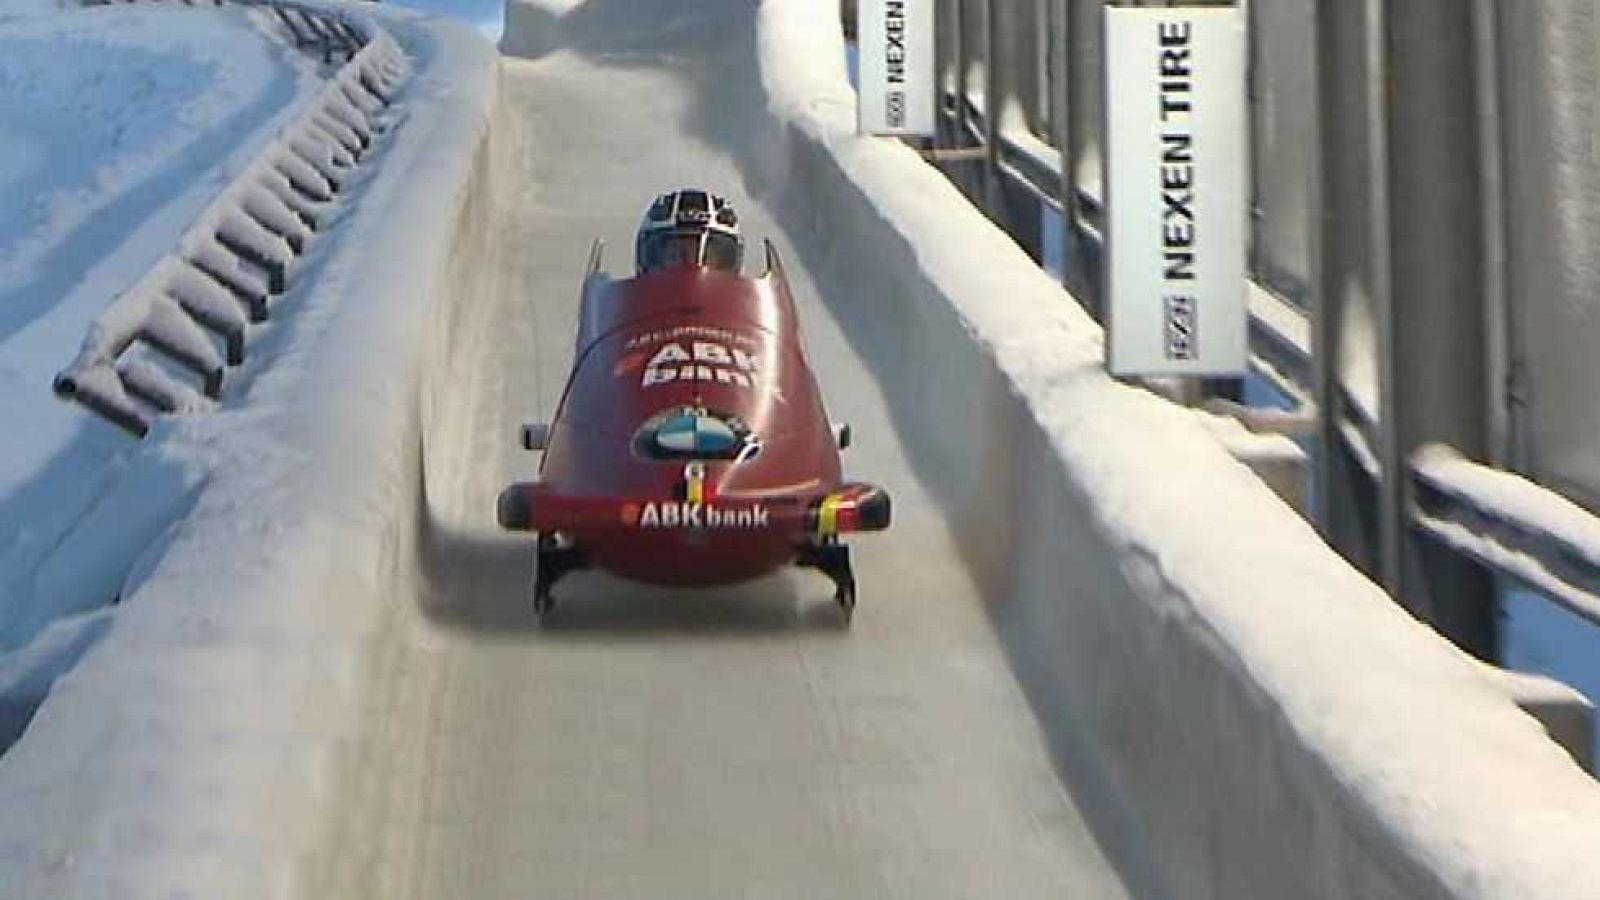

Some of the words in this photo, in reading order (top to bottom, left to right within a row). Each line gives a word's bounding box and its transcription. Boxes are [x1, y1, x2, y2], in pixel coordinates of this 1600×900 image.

[886, 1, 904, 82] NEXEN
[1159, 21, 1191, 121] TIRE
[1162, 134, 1194, 279] NEXEN
[640, 502, 701, 528] ABK
[706, 503, 770, 527] bank
